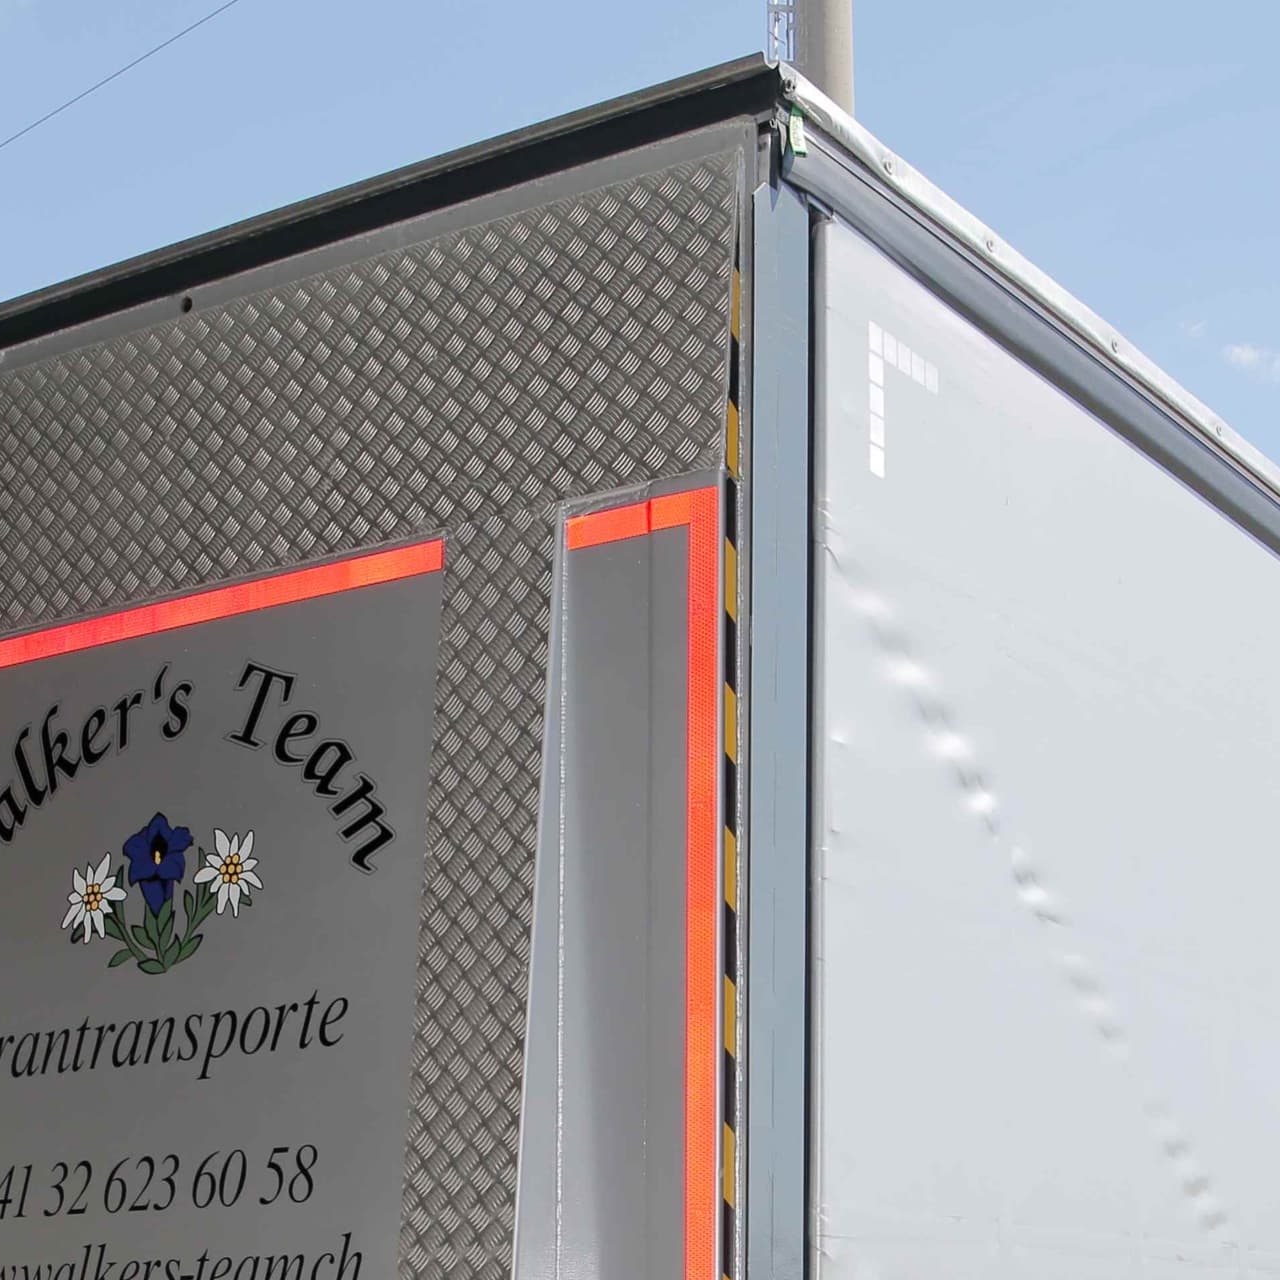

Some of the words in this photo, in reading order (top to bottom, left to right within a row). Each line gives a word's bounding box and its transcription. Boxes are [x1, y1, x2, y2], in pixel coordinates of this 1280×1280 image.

[228, 661, 395, 873] Team
[43, 1159, 94, 1217] 32
[103, 1153, 180, 1214] 623
[192, 1148, 247, 1210] 60
[259, 1143, 320, 1206] 58
